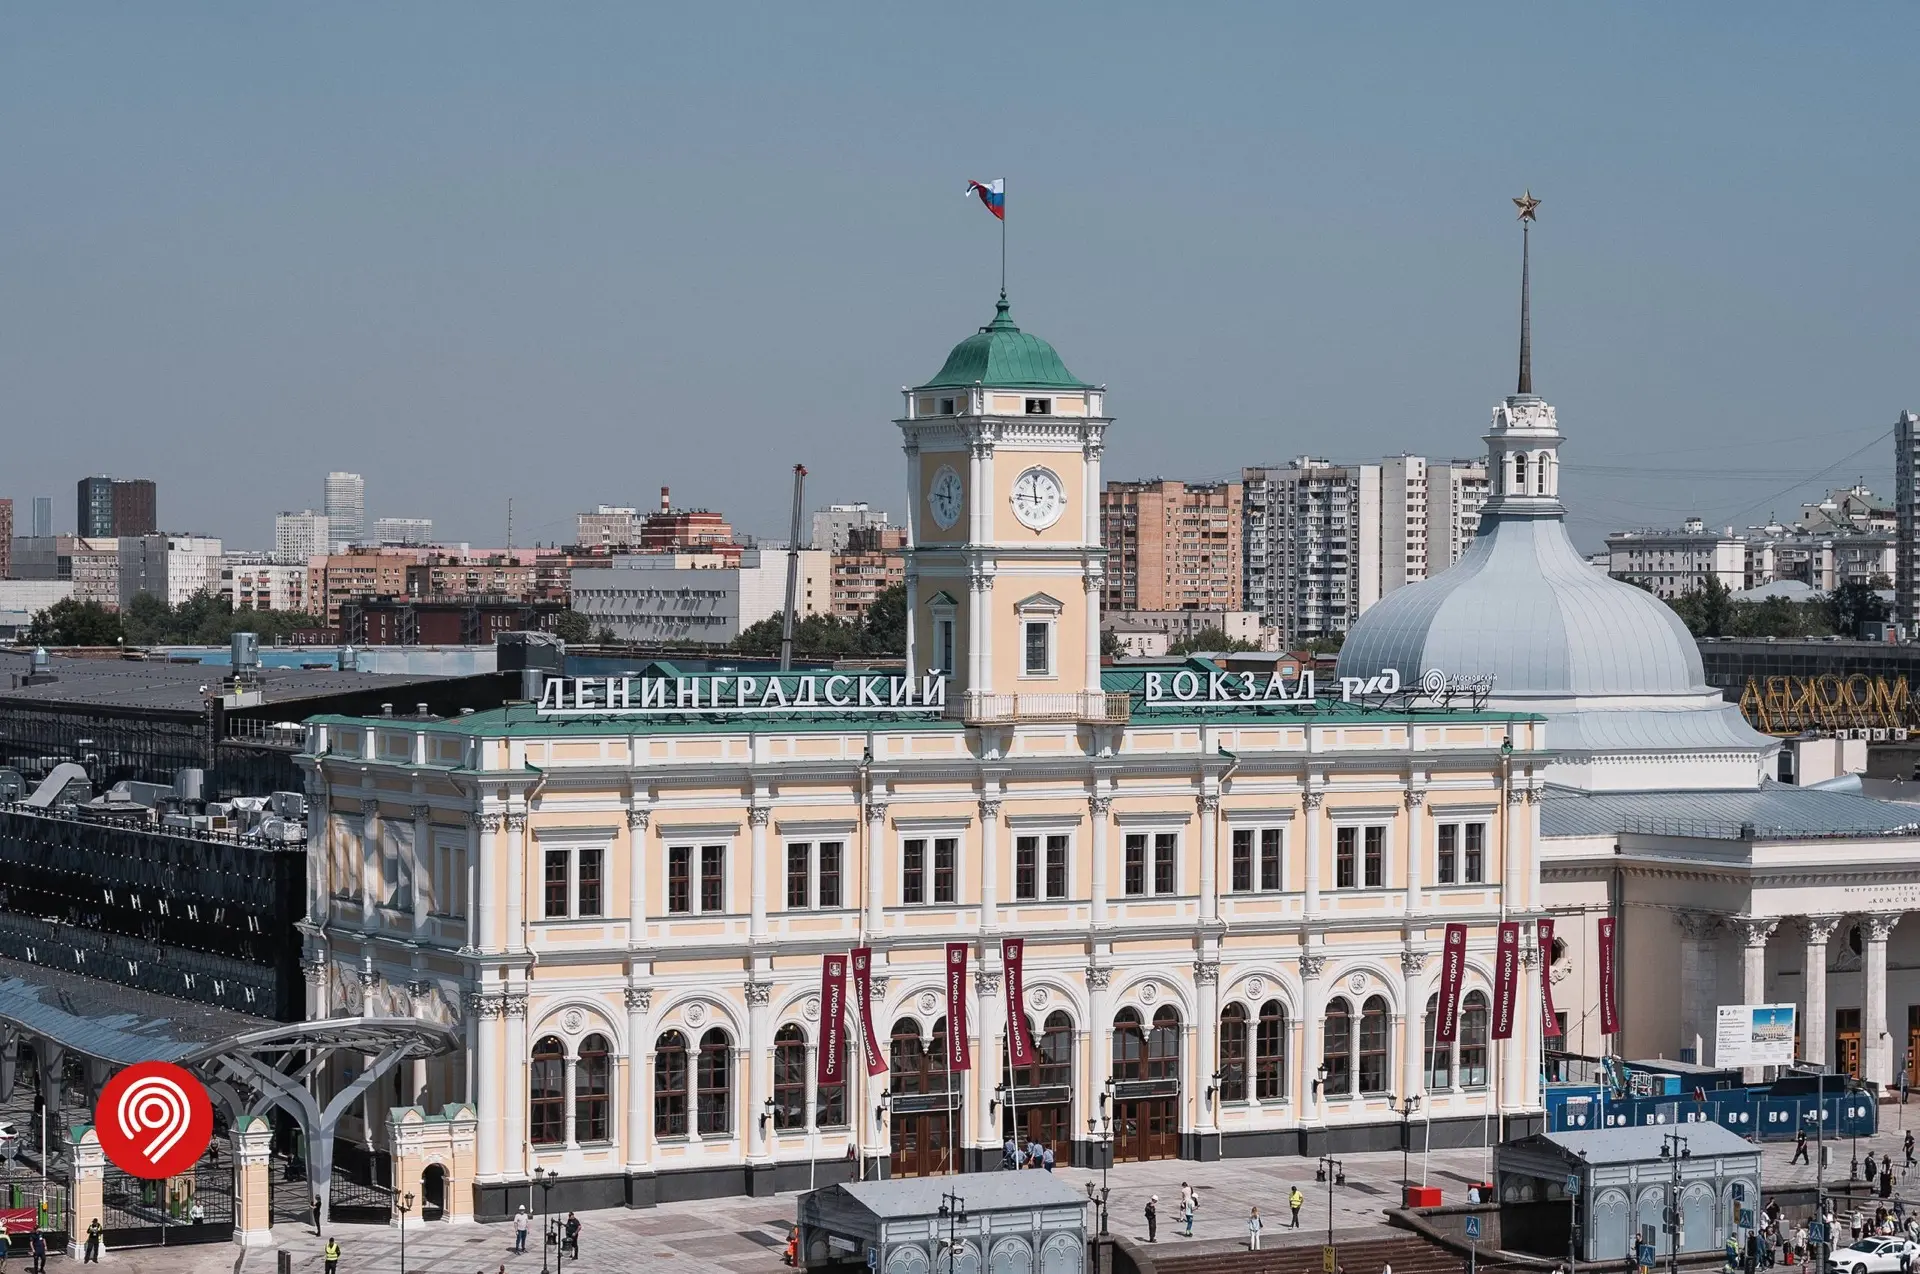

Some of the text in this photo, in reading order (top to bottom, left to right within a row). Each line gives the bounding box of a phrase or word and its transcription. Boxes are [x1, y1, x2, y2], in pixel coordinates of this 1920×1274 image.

[537, 668, 1316, 709] ЛЕНИНГРАДСКИЙ ВОКЗАЛ
[1452, 673, 1497, 682] Московский
[830, 984, 839, 1017] городу!
[1443, 993, 1454, 1036] Строители
[1450, 951, 1458, 982] городу!
[1499, 991, 1509, 1033] Строители
[1504, 950, 1512, 981] городу!
[826, 1029, 837, 1075] Строители
[952, 1016, 962, 1062] Строители
[1011, 1011, 1024, 1057] Строители
